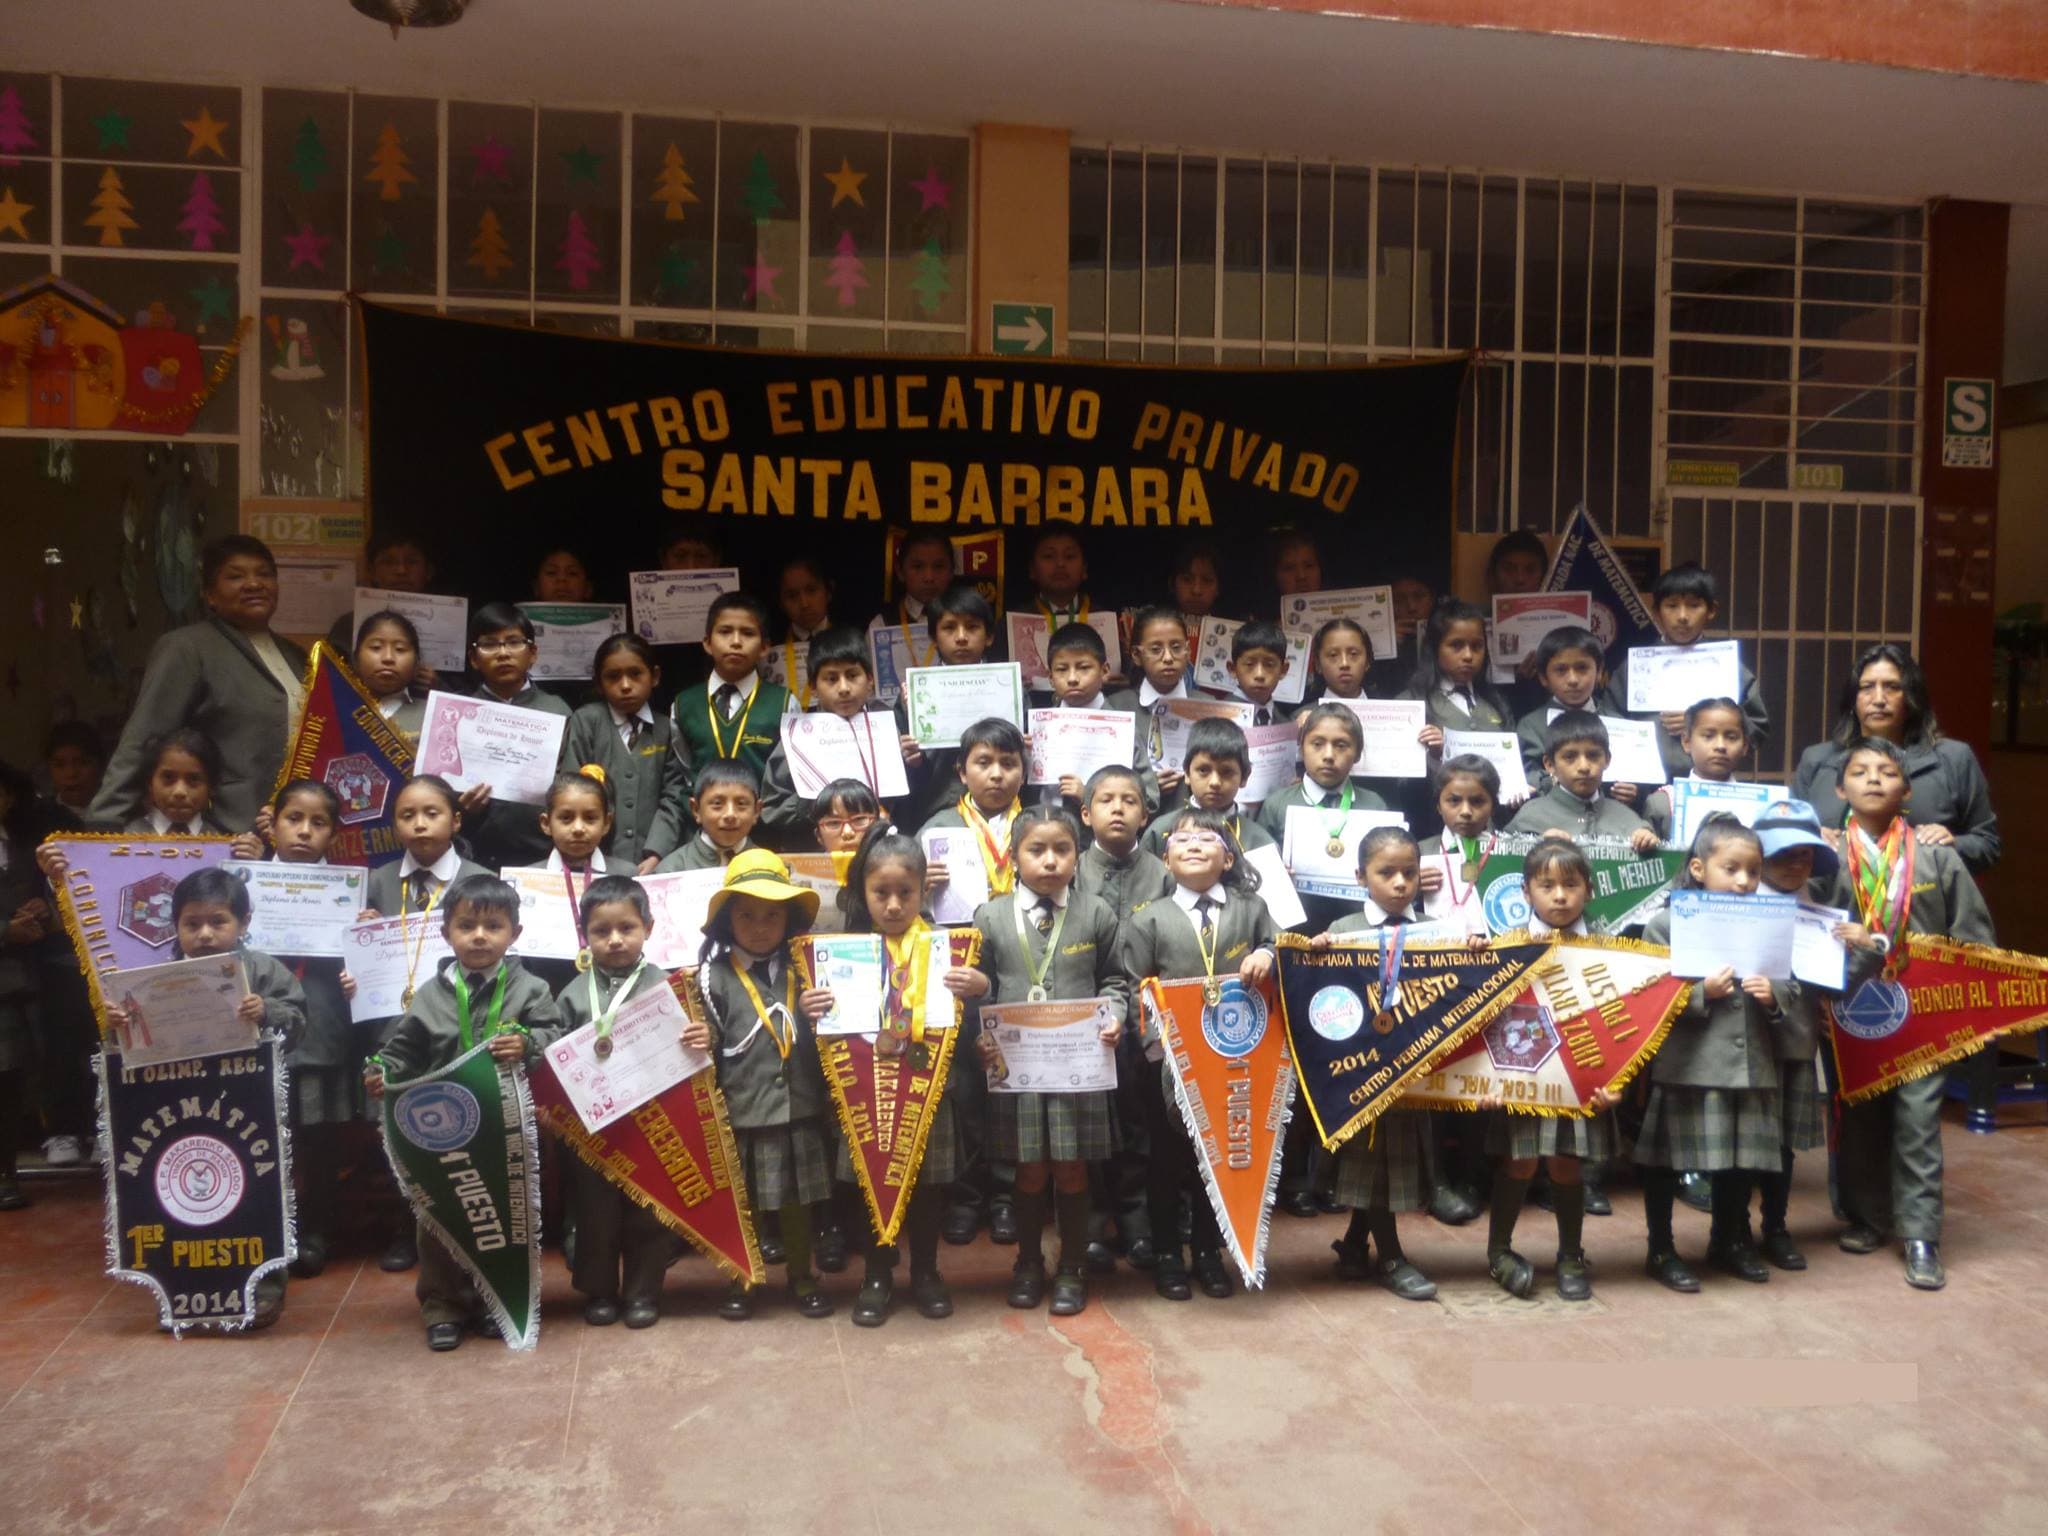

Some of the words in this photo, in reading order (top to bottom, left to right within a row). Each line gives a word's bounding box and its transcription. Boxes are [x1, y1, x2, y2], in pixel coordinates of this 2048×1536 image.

[1951, 386, 1987, 432] S
[484, 389, 730, 491] CENTRO
[767, 375, 1100, 440] EDUCATIVO
[1132, 402, 1360, 513] PRIVADO
[662, 449, 882, 520] SANTA
[910, 461, 1213, 526] BARBARA
[1802, 466, 1837, 486] 101
[253, 516, 311, 540] 102
[1618, 858, 1665, 891] MERITO
[1412, 954, 1426, 967] DE
[1909, 983, 1964, 1014] HONOR
[1968, 980, 1993, 1007] AL
[1997, 979, 2048, 1008] MERIT
[1349, 1066, 1393, 1105] CENTRO
[1393, 1025, 1443, 1070] PERUANA
[1441, 958, 1524, 1028] INTERNACIONAL
[143, 1059, 208, 1083] OLIMP.
[219, 1055, 265, 1077] REG.
[1328, 1047, 1381, 1078] 2014
[909, 1075, 930, 1097] DE
[1226, 1078, 1252, 1170] PUESTO
[163, 1138, 224, 1166] MAKARENKO
[448, 1166, 508, 1251] PUESTO
[172, 1237, 265, 1268] PUESTO
[174, 1289, 242, 1315] 2014
